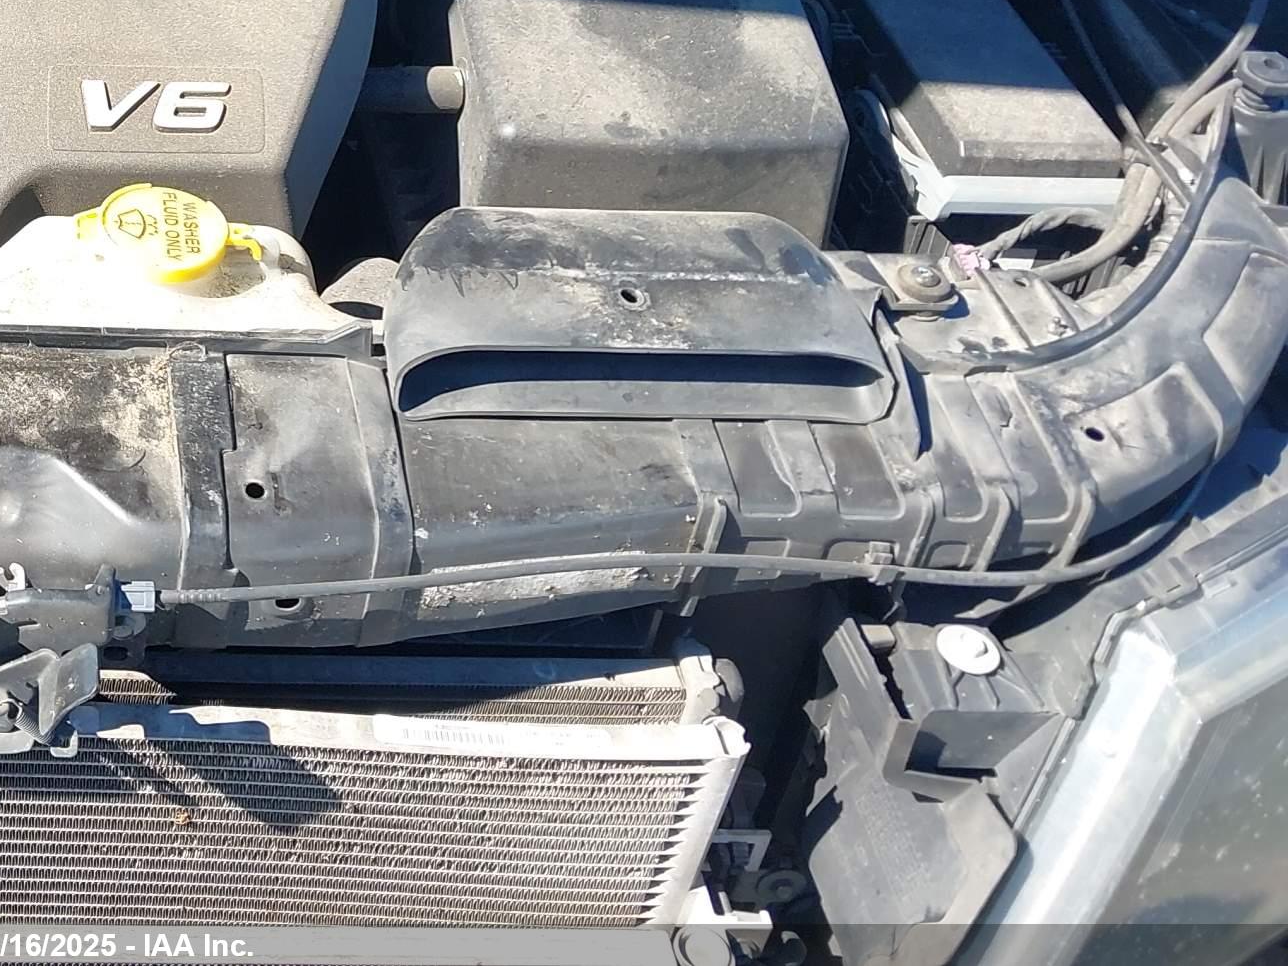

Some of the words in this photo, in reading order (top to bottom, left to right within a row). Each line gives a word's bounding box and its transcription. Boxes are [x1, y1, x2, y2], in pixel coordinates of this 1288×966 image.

[81, 79, 231, 133] V6
[162, 191, 179, 226] FLUID
[183, 202, 201, 254] WASHER
[165, 230, 183, 261] ONLY
